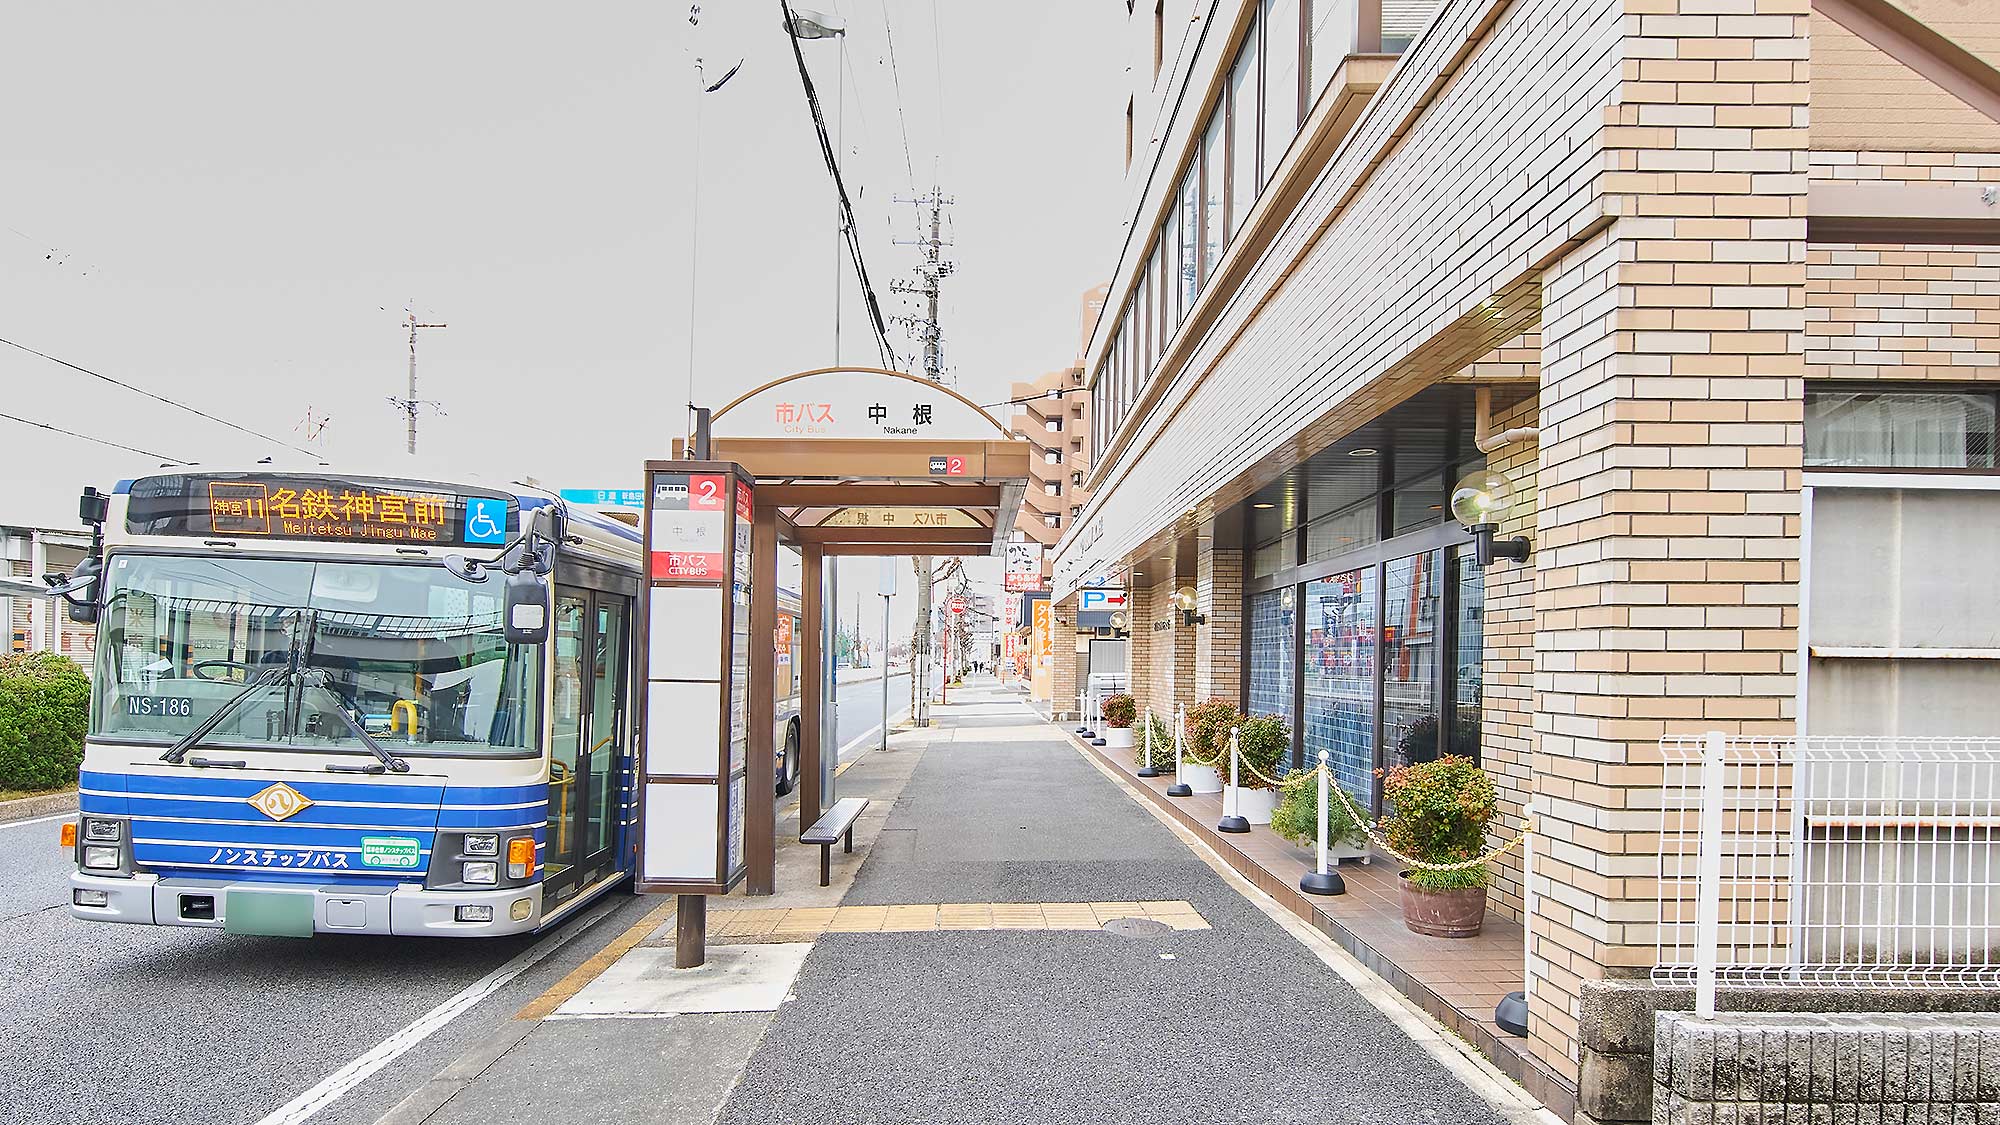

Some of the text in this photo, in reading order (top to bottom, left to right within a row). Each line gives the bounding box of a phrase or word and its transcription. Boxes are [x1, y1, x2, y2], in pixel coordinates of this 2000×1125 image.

[775, 402, 834, 425] 市バス
[784, 425, 826, 435] City Bus
[883, 426, 918, 435] Nakane
[950, 458, 962, 474] 2
[698, 480, 717, 505] 2
[269, 487, 447, 525] 名鉄神宮前
[284, 520, 437, 540] Meitetsu Jingu Mae
[668, 554, 707, 567] 市バス
[1083, 591, 1106, 608] P
[128, 697, 190, 717] NS-186
[209, 847, 350, 869] ノンステップバス
